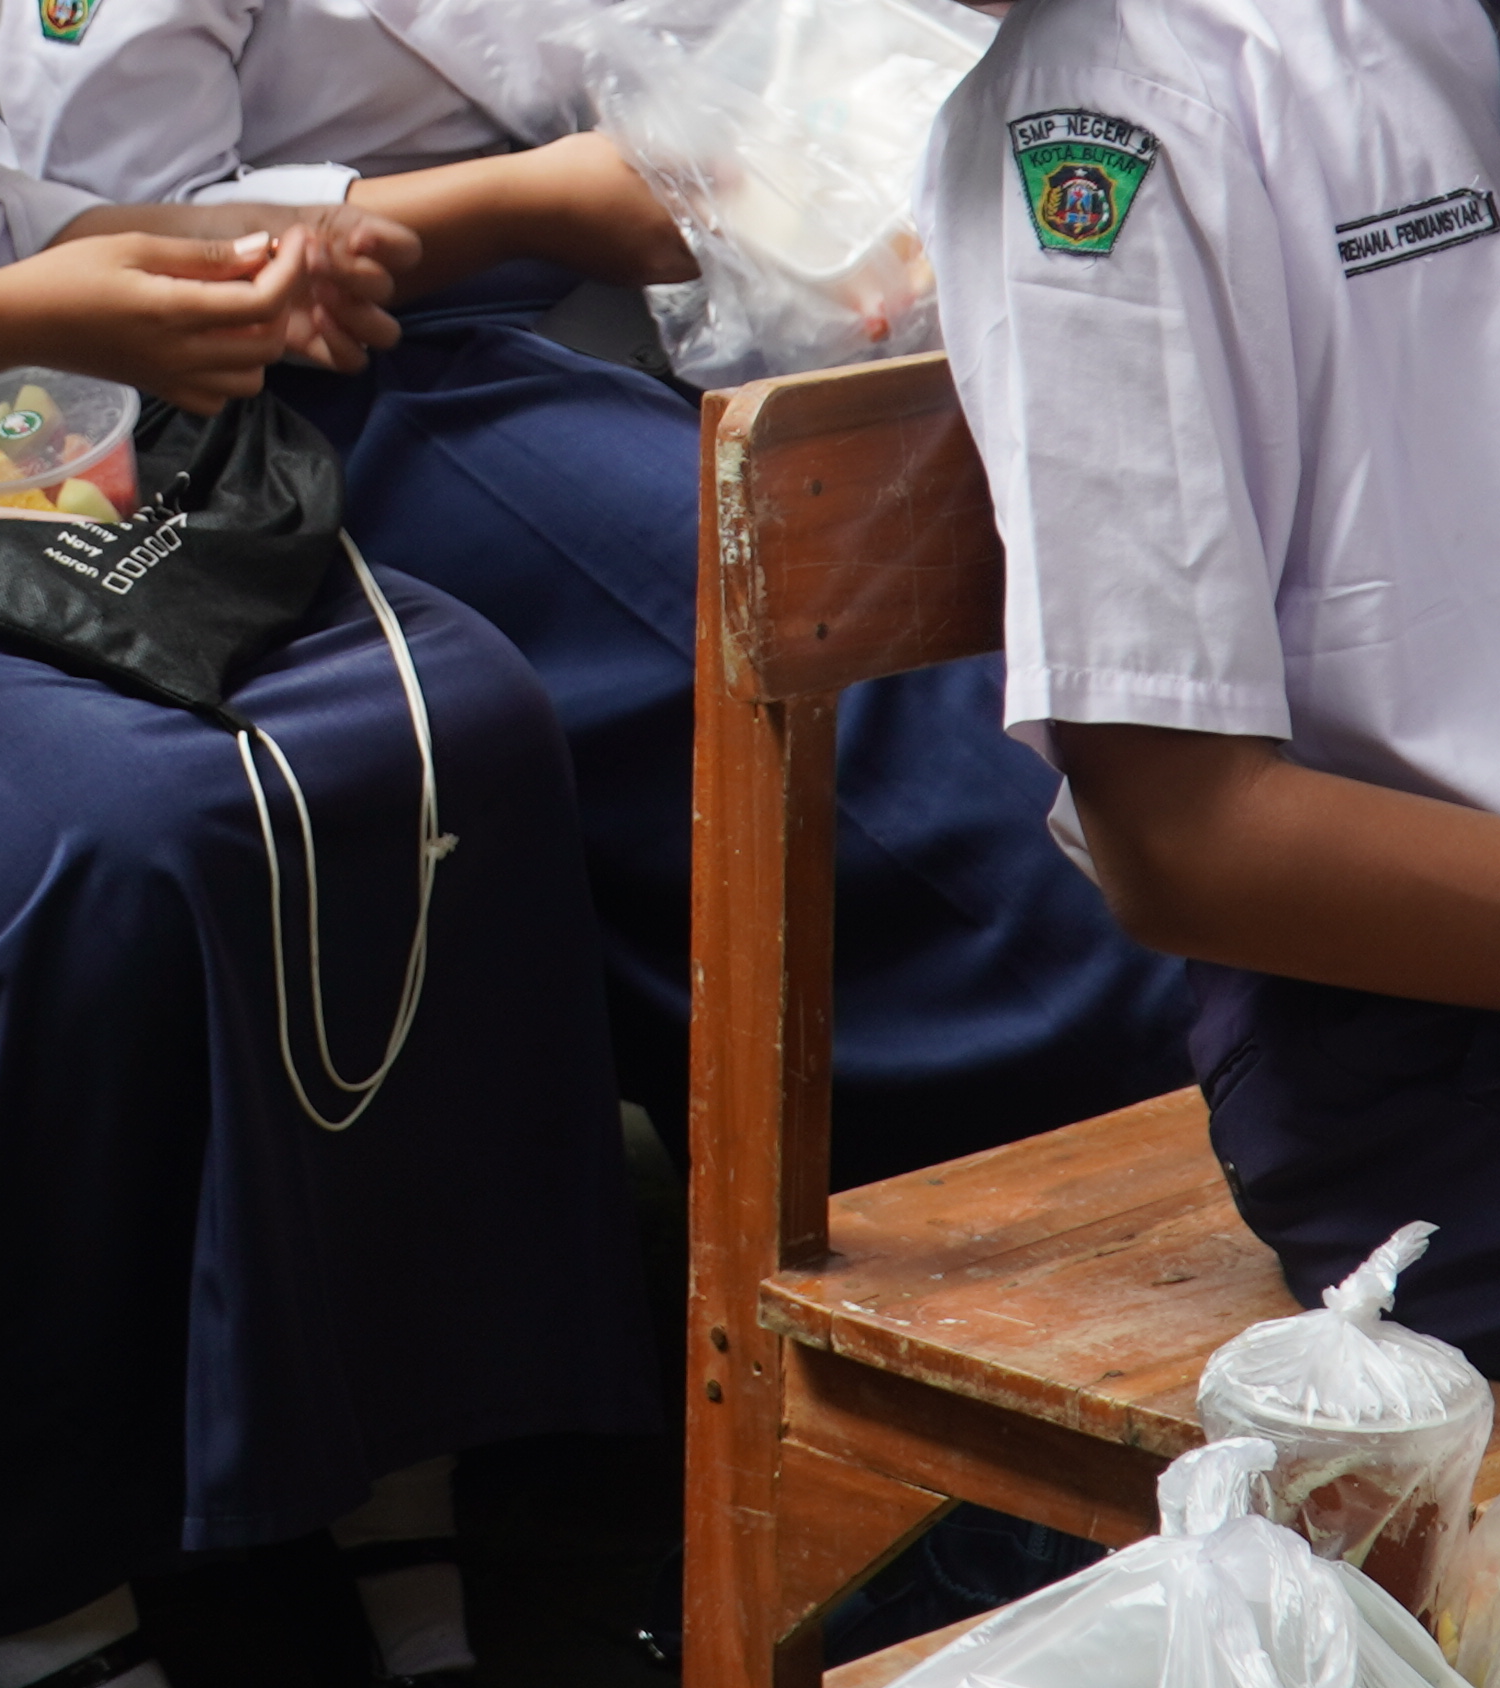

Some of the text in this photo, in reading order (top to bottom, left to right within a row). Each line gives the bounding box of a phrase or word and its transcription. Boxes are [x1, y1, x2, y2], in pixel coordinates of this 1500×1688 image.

[1018, 120, 1055, 146] SMP
[1067, 115, 1134, 148] NEGERI
[1029, 144, 1074, 169] KOTA
[57, 530, 103, 558] Navy
[43, 547, 100, 579] Maron
